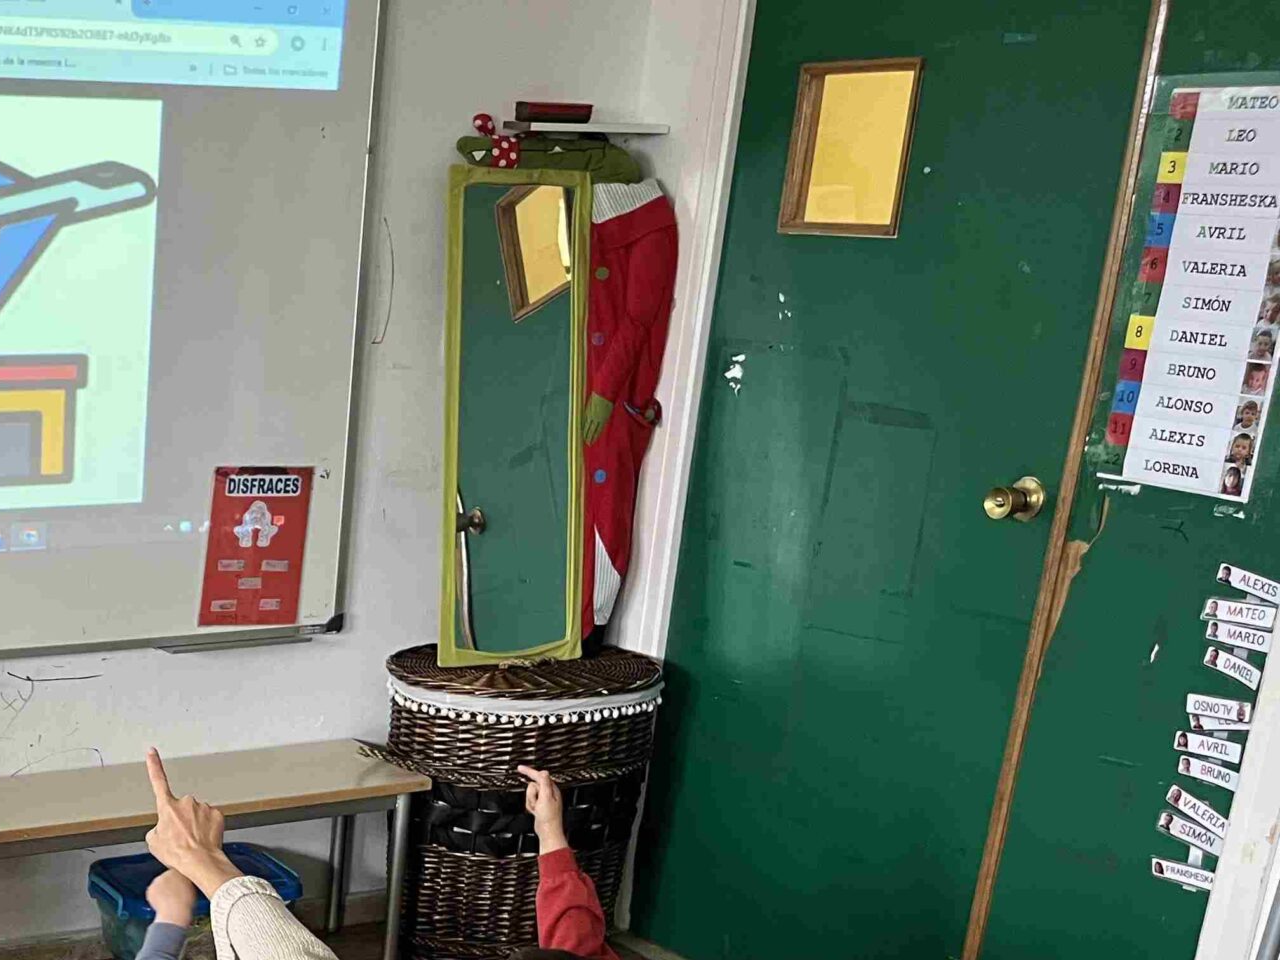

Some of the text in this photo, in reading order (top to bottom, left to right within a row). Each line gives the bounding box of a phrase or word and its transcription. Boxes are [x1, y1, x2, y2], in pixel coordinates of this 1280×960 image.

[1228, 96, 1278, 109] MATEO
[1175, 128, 1257, 142] 2 LEO
[1168, 161, 1260, 175] 3 MARIO
[1163, 191, 1278, 208] 4 FRANSHESKA
[1156, 223, 1246, 240] 5 AVRIL
[1150, 258, 1247, 277] 6 VALERIA
[1182, 296, 1231, 312] SIMÓN
[1135, 326, 1228, 347] 8 DANIEL
[1130, 358, 1216, 380] 9 BRUNO
[1119, 390, 1214, 414] 10 ALONSO
[1112, 422, 1205, 447] 11 ALEXIS
[1144, 459, 1199, 479] LORENA
[227, 477, 300, 494] DISFRACES
[1239, 574, 1279, 597] ALEXIS
[1226, 604, 1266, 621] MATEO
[1226, 628, 1265, 646] MARIO
[1223, 658, 1253, 683] DANIEL
[1198, 738, 1230, 756] AVRIL
[1200, 764, 1231, 784] BRUNO
[1183, 797, 1226, 832] VALERIA
[1179, 824, 1216, 848] SIMÓN
